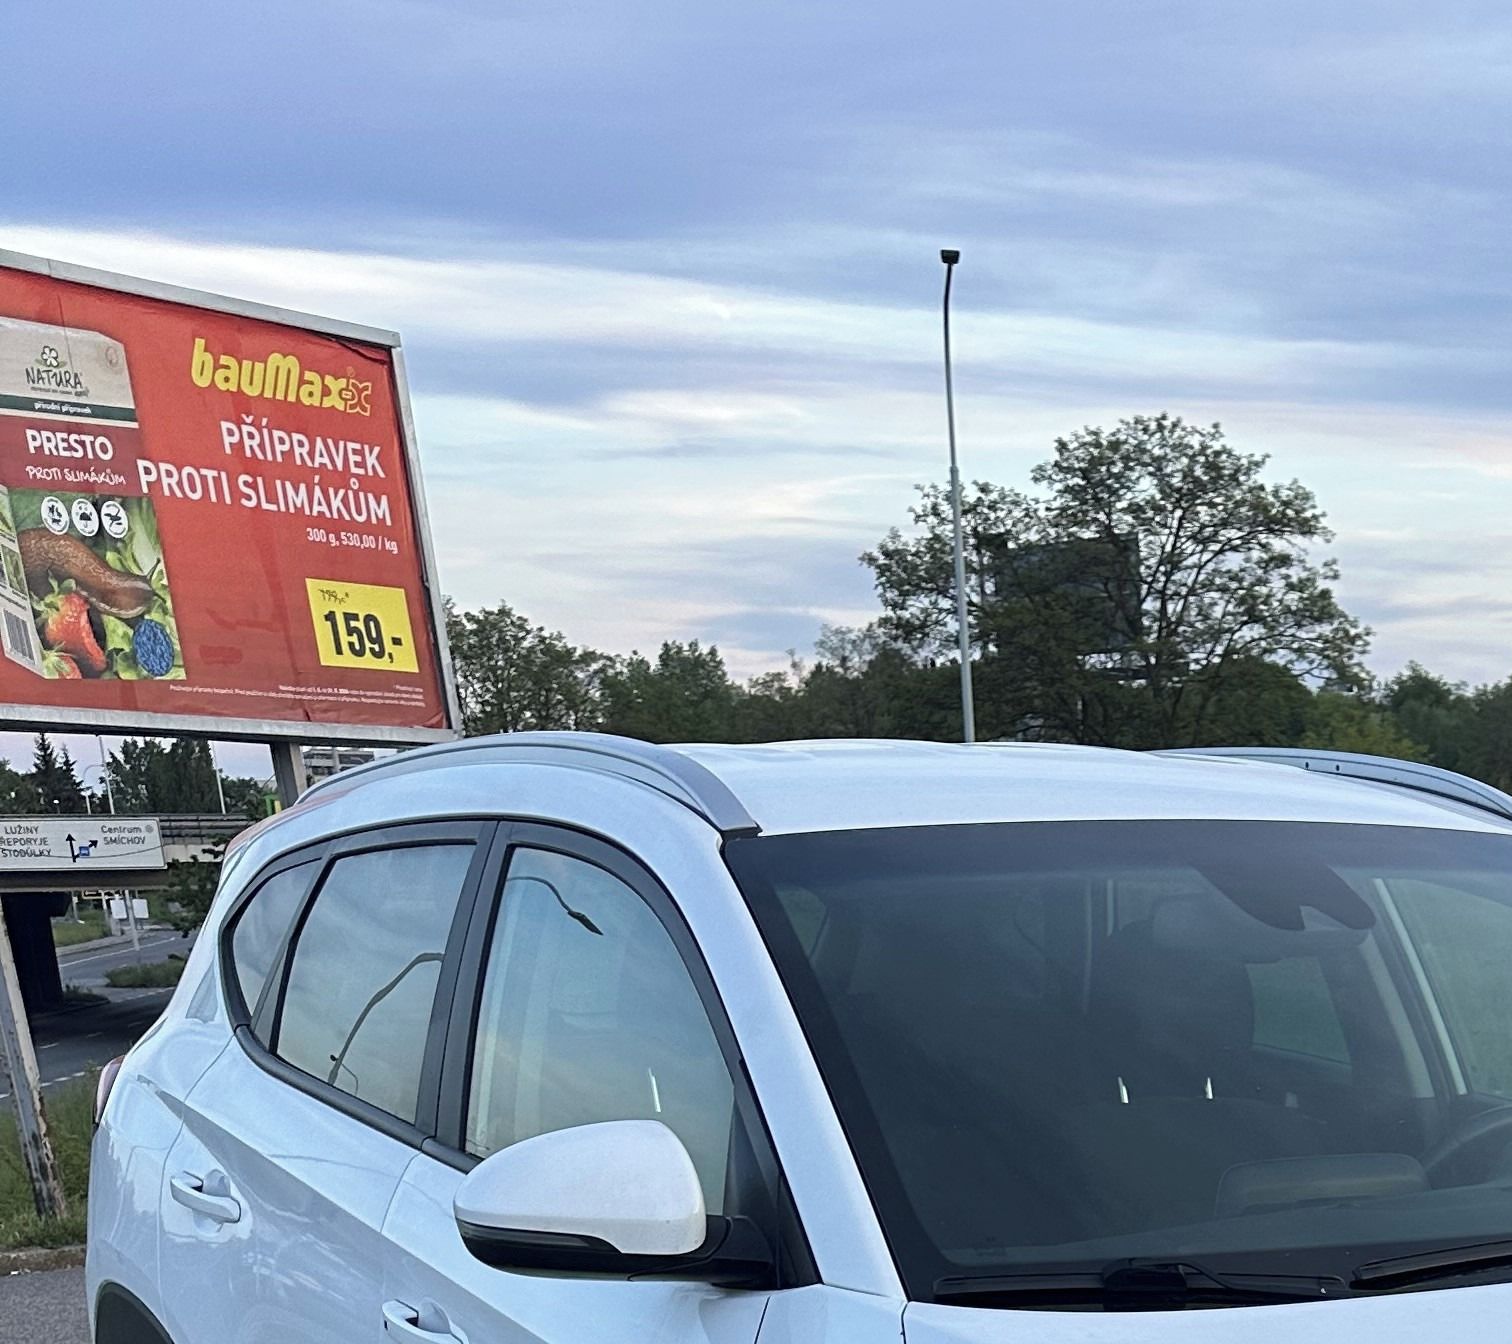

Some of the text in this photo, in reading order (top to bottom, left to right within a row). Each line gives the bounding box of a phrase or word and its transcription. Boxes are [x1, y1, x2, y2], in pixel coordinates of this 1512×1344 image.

[25, 367, 84, 390] NATURA
[25, 428, 114, 461] PRESTO
[220, 413, 386, 479] PŘÍPRAVEK
[25, 465, 126, 486] PROTI SLIMÁKŮM
[136, 458, 392, 527] PROTI SLIMÁKŮM
[306, 527, 327, 543] 300
[328, 533, 340, 547] g,
[340, 531, 376, 549] 530,00
[384, 537, 399, 555] kg
[323, 610, 403, 664] 159,-
[4, 824, 39, 835] LUŽINY
[100, 825, 142, 834] Centrum
[103, 834, 146, 845] SMÍCHOV
